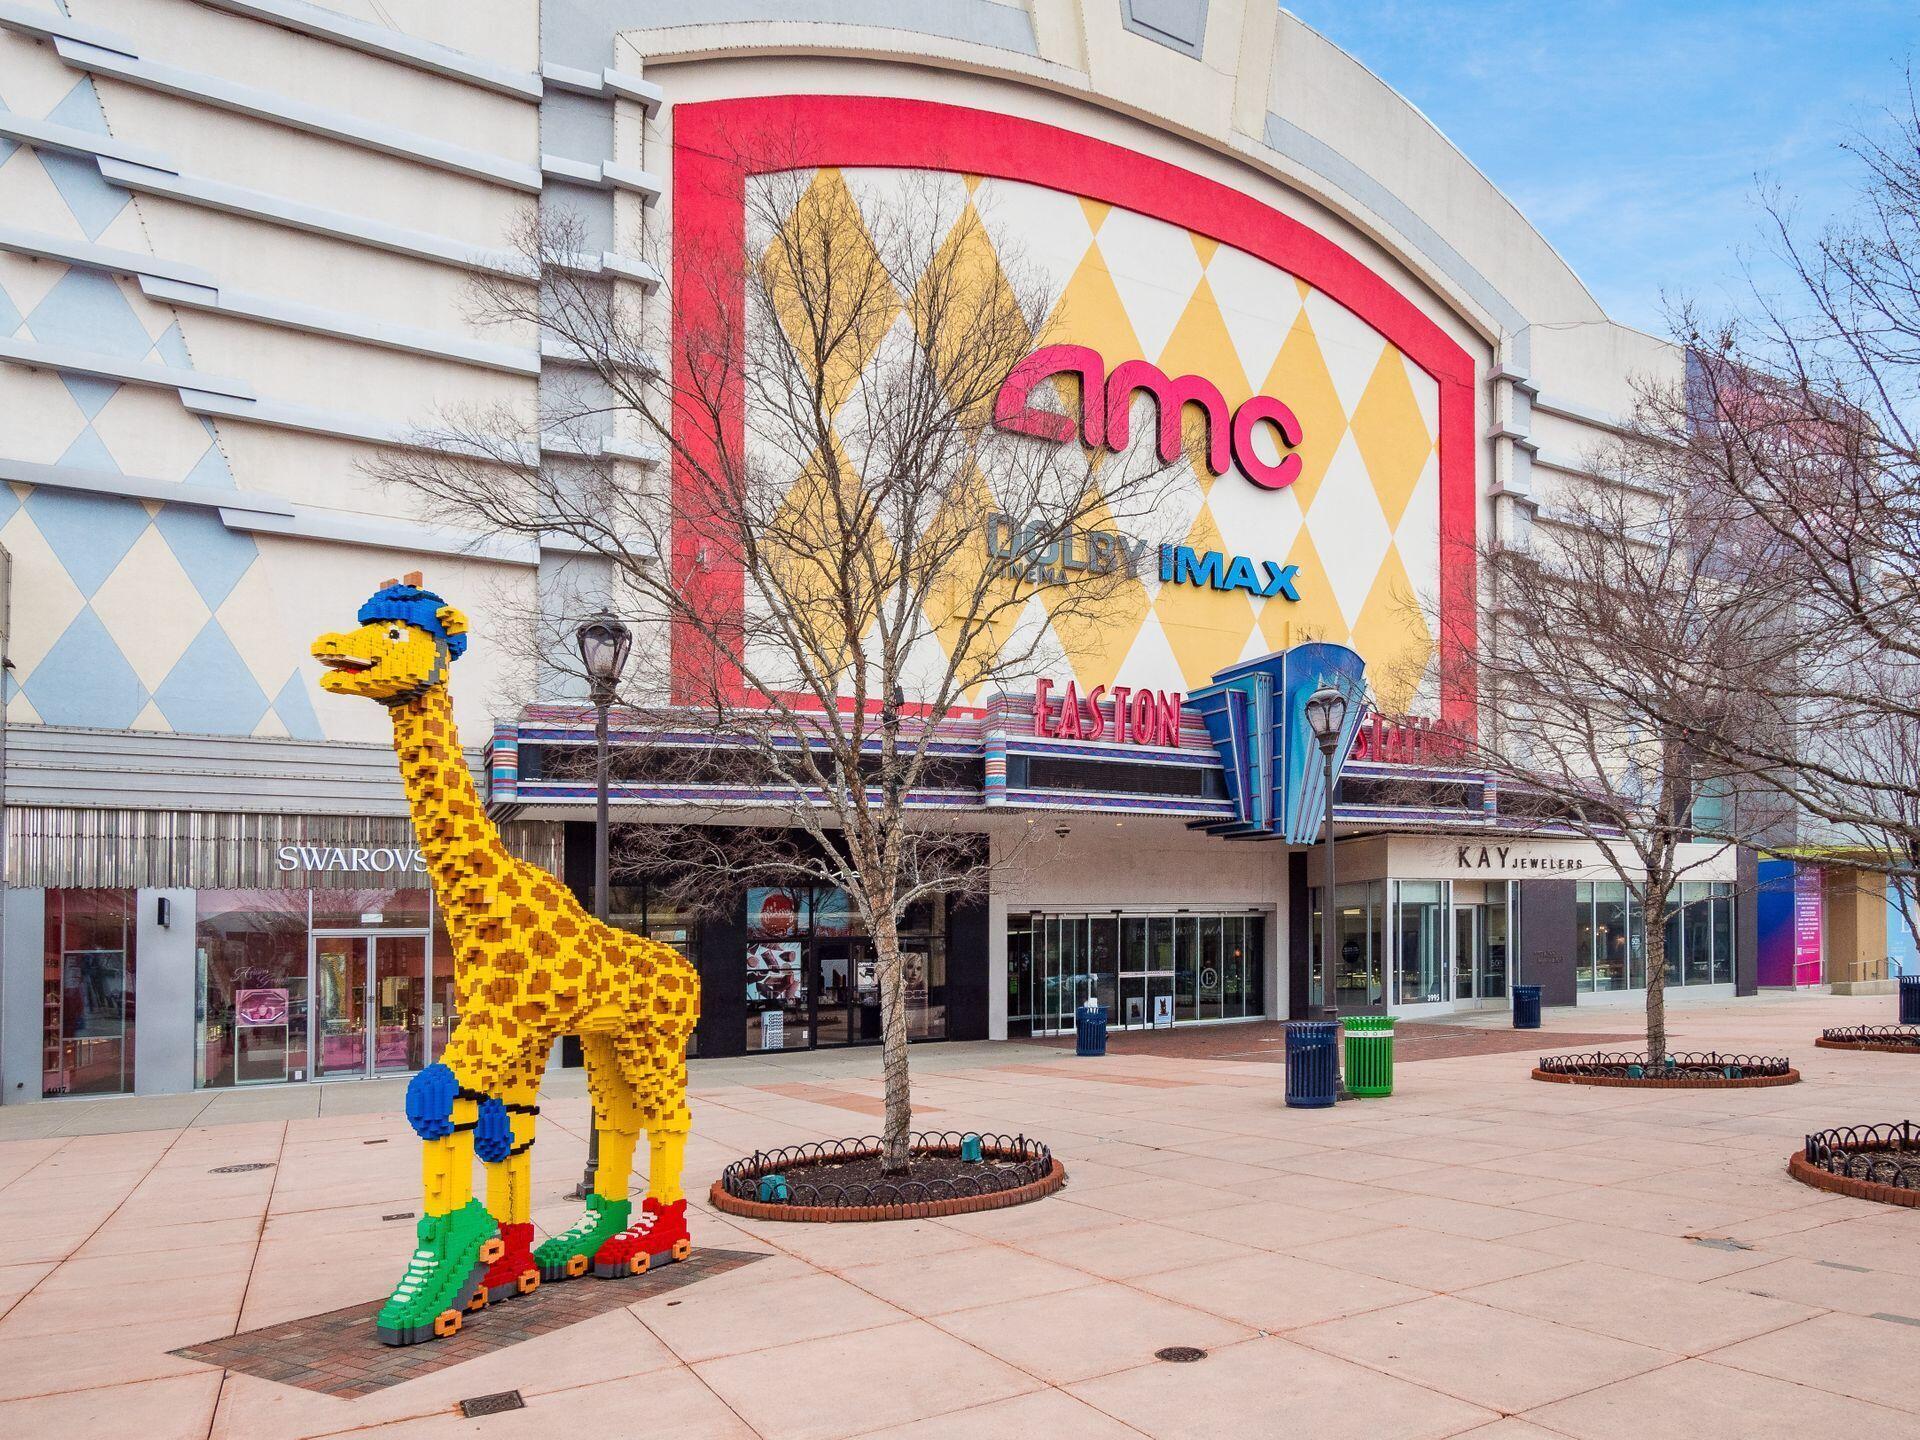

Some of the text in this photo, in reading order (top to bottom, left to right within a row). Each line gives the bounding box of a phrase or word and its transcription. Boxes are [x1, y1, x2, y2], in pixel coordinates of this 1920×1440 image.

[993, 343, 1304, 490] amc
[986, 511, 1148, 580] DOLBY
[990, 557, 1068, 584] INEMA
[1159, 542, 1302, 602] IMAX
[1033, 678, 1182, 748] EASTON
[1457, 845, 1583, 869] KAY JEWELERS
